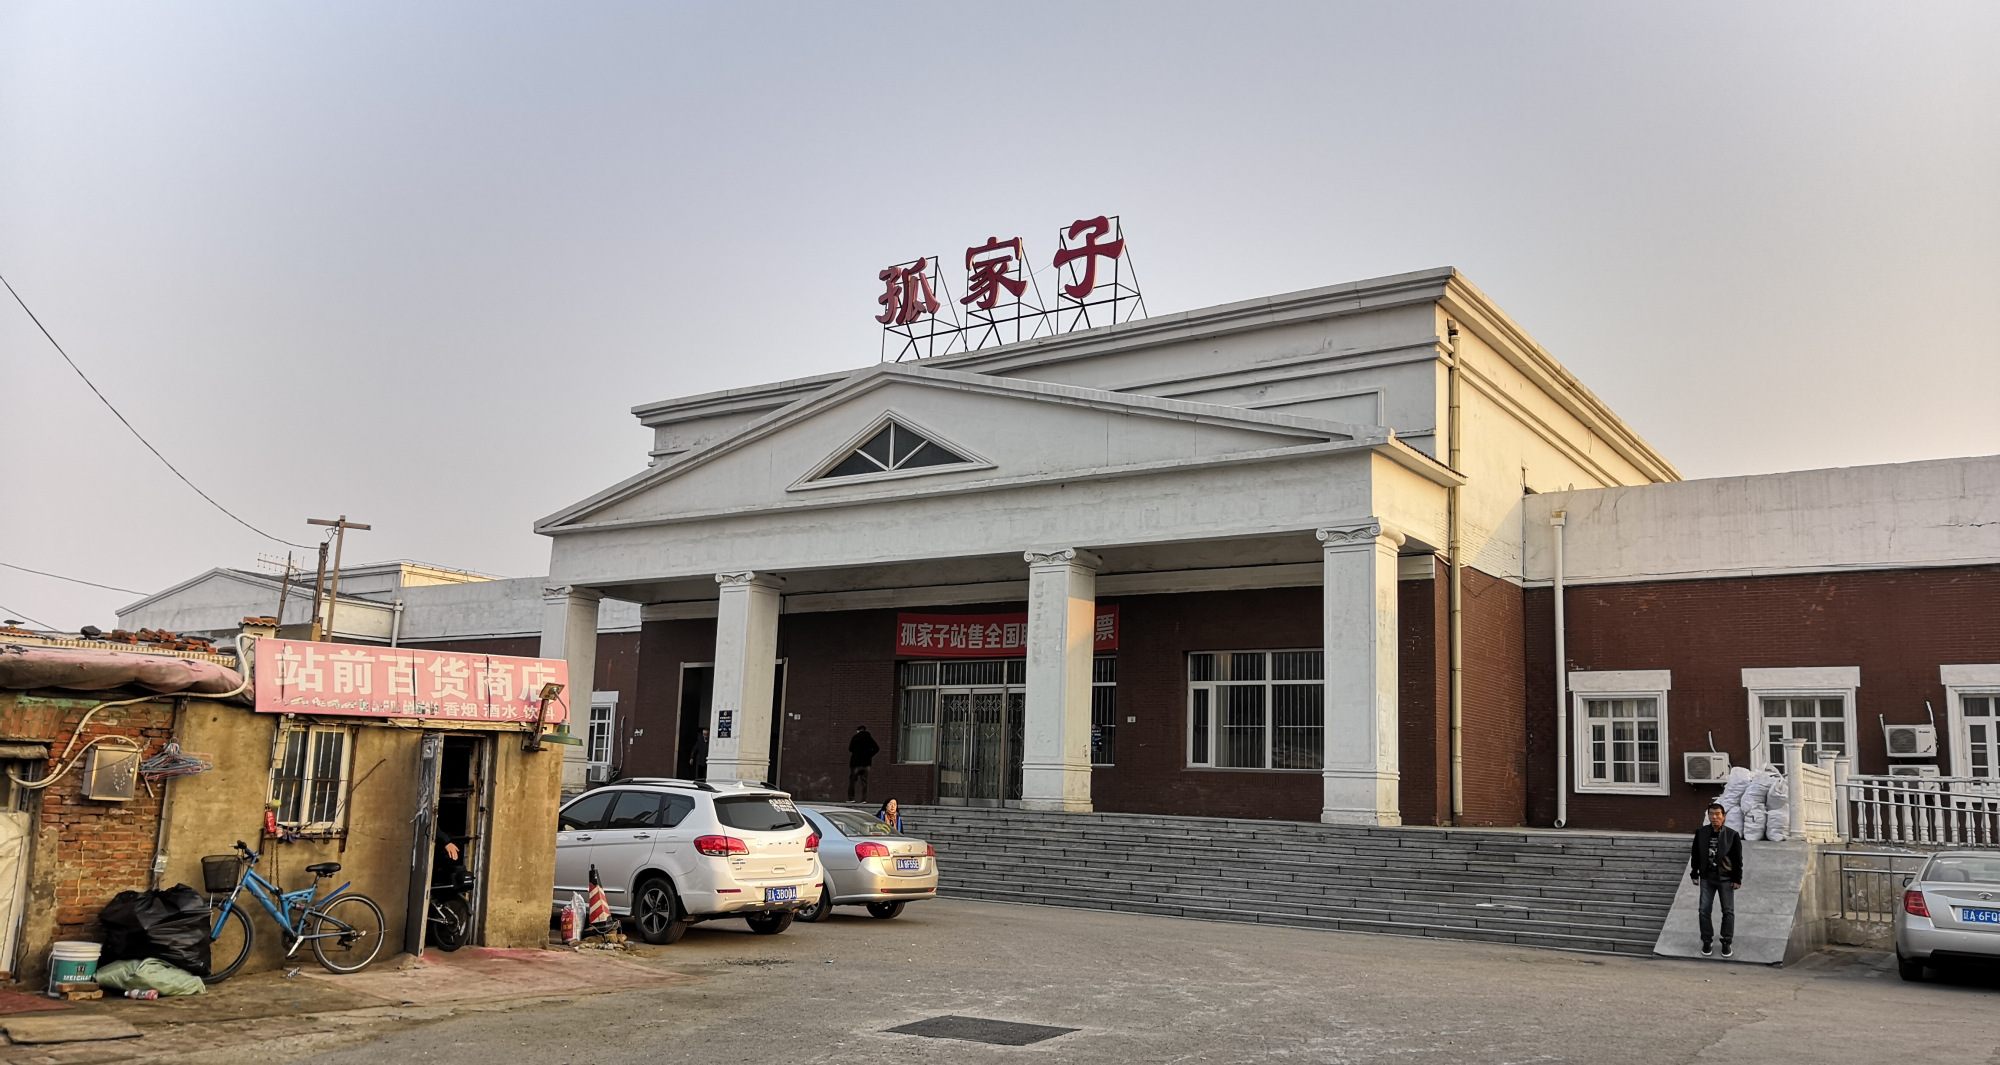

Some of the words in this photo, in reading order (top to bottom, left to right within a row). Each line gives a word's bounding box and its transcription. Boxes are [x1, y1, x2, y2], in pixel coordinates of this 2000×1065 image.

[875, 216, 1125, 325] 孤家子
[274, 645, 556, 703] 站前百货商店
[443, 701, 478, 718] 香烟
[483, 703, 518, 719] 酒水
